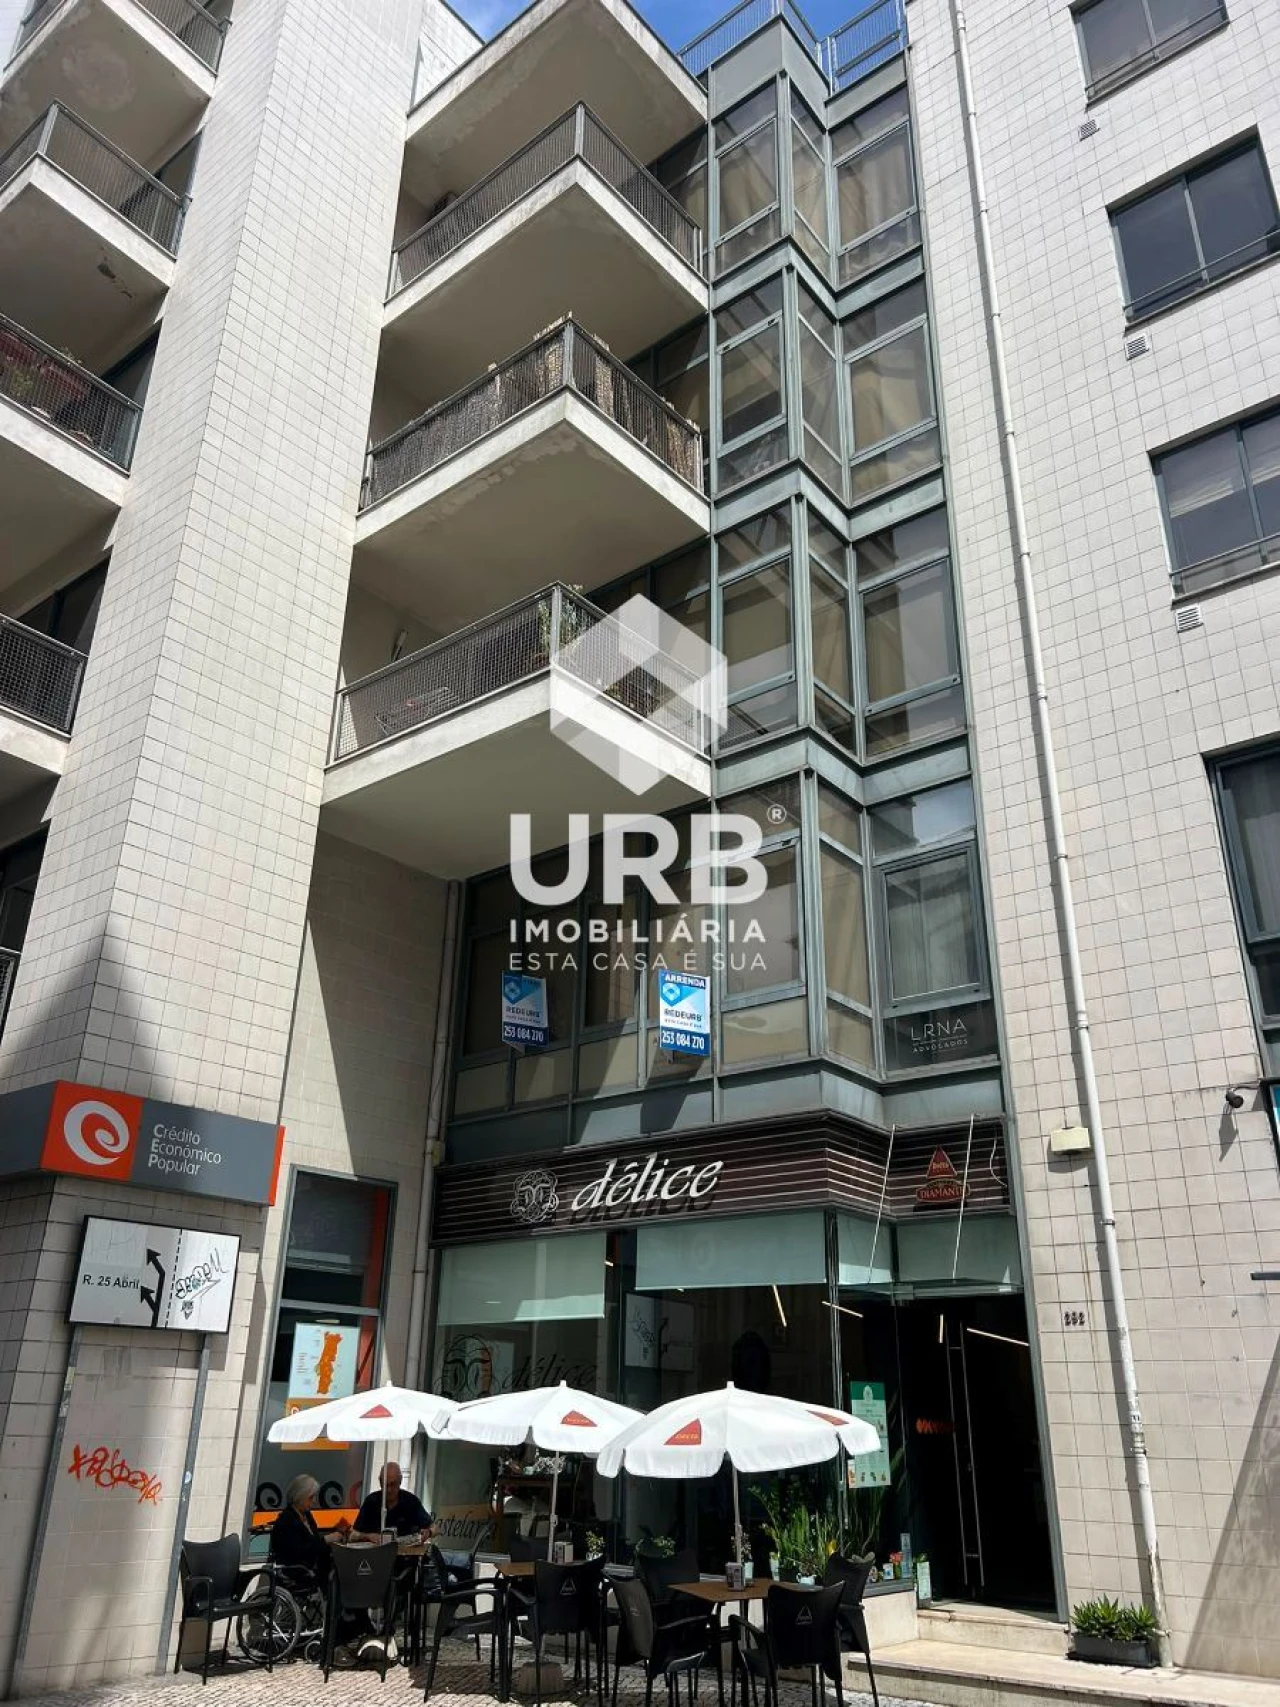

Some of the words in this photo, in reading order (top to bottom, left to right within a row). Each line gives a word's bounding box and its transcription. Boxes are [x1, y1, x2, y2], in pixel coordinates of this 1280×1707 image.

[665, 973, 706, 988] ARRENDA
[504, 1025, 516, 1038] 253
[517, 1027, 531, 1040] 084
[662, 1030, 675, 1045] 253
[676, 1033, 691, 1047] 084
[692, 1036, 705, 1050] 270
[911, 1018, 967, 1041] LRNA
[153, 1124, 201, 1145] Crédito
[151, 1138, 222, 1165] Económico
[148, 1153, 201, 1175] Popular
[571, 1152, 724, 1211] délice
[82, 1274, 94, 1285] R.
[97, 1275, 111, 1287] 25
[113, 1276, 141, 1290] Abril
